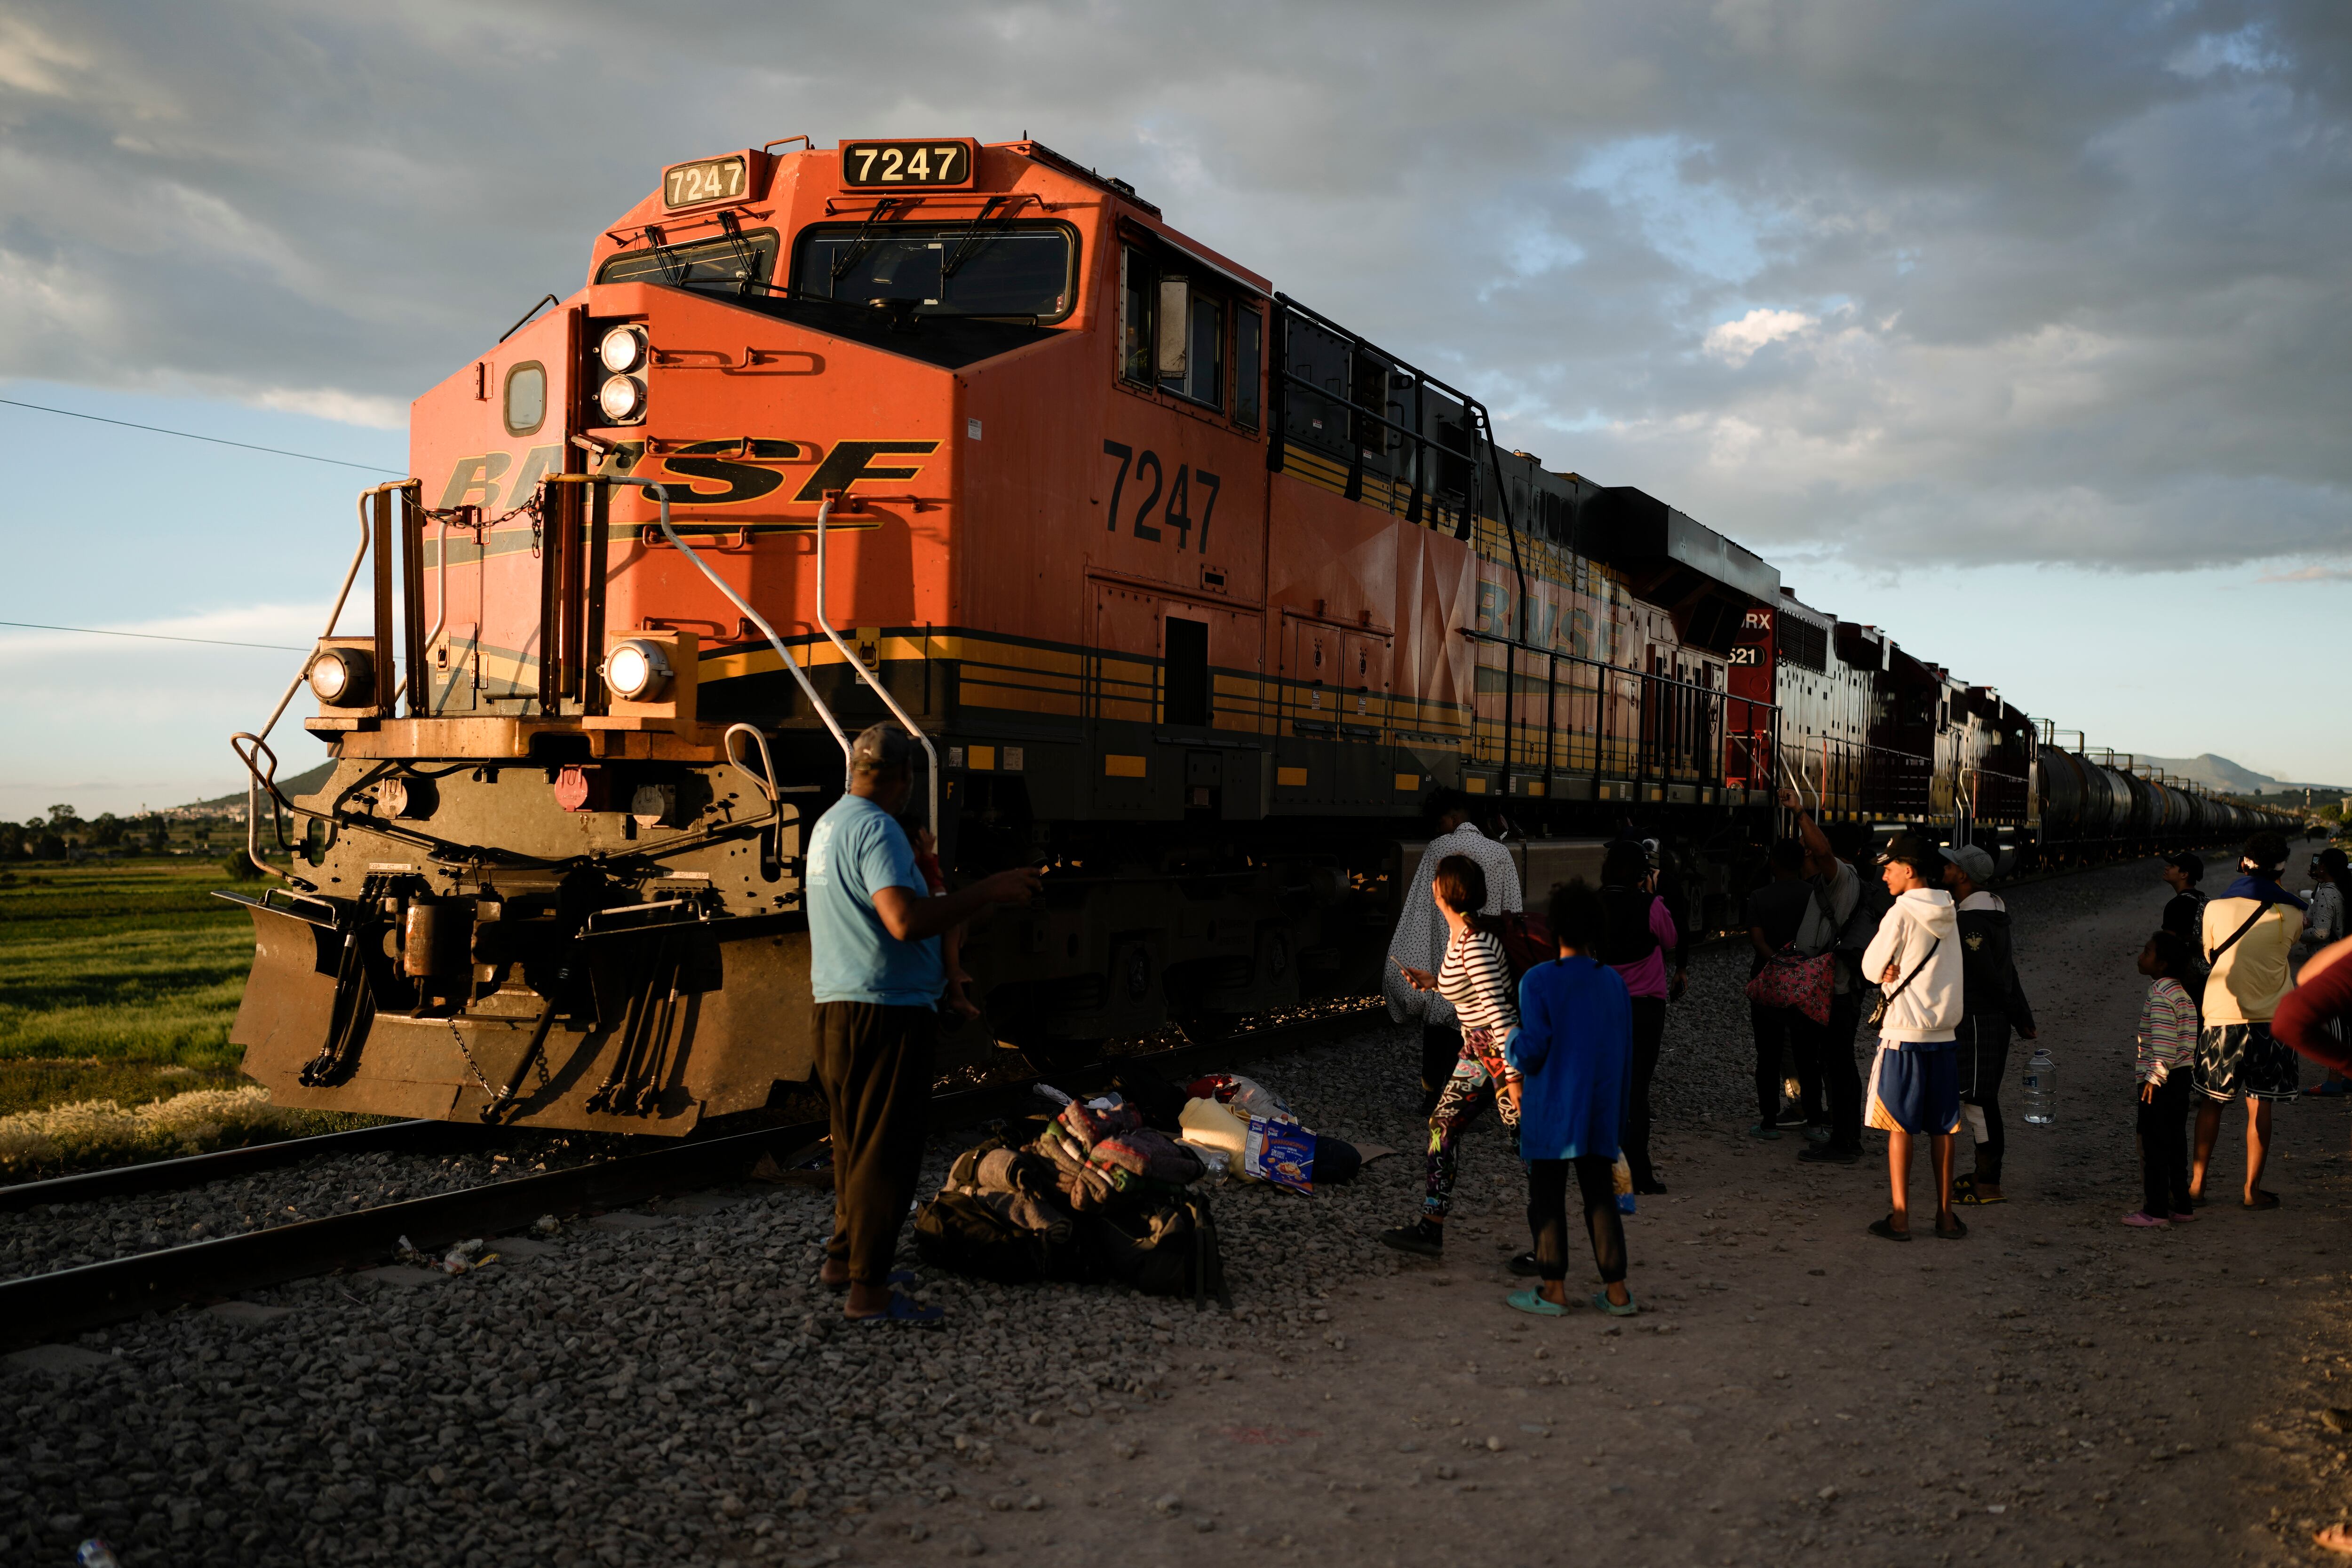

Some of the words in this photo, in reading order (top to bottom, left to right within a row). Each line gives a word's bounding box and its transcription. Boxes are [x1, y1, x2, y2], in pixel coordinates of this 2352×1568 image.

[856, 147, 958, 182] 7247
[669, 162, 742, 204] 7247
[1103, 438, 1220, 555] 7247
[1741, 613, 1771, 629] RX
[947, 781, 954, 800] F
